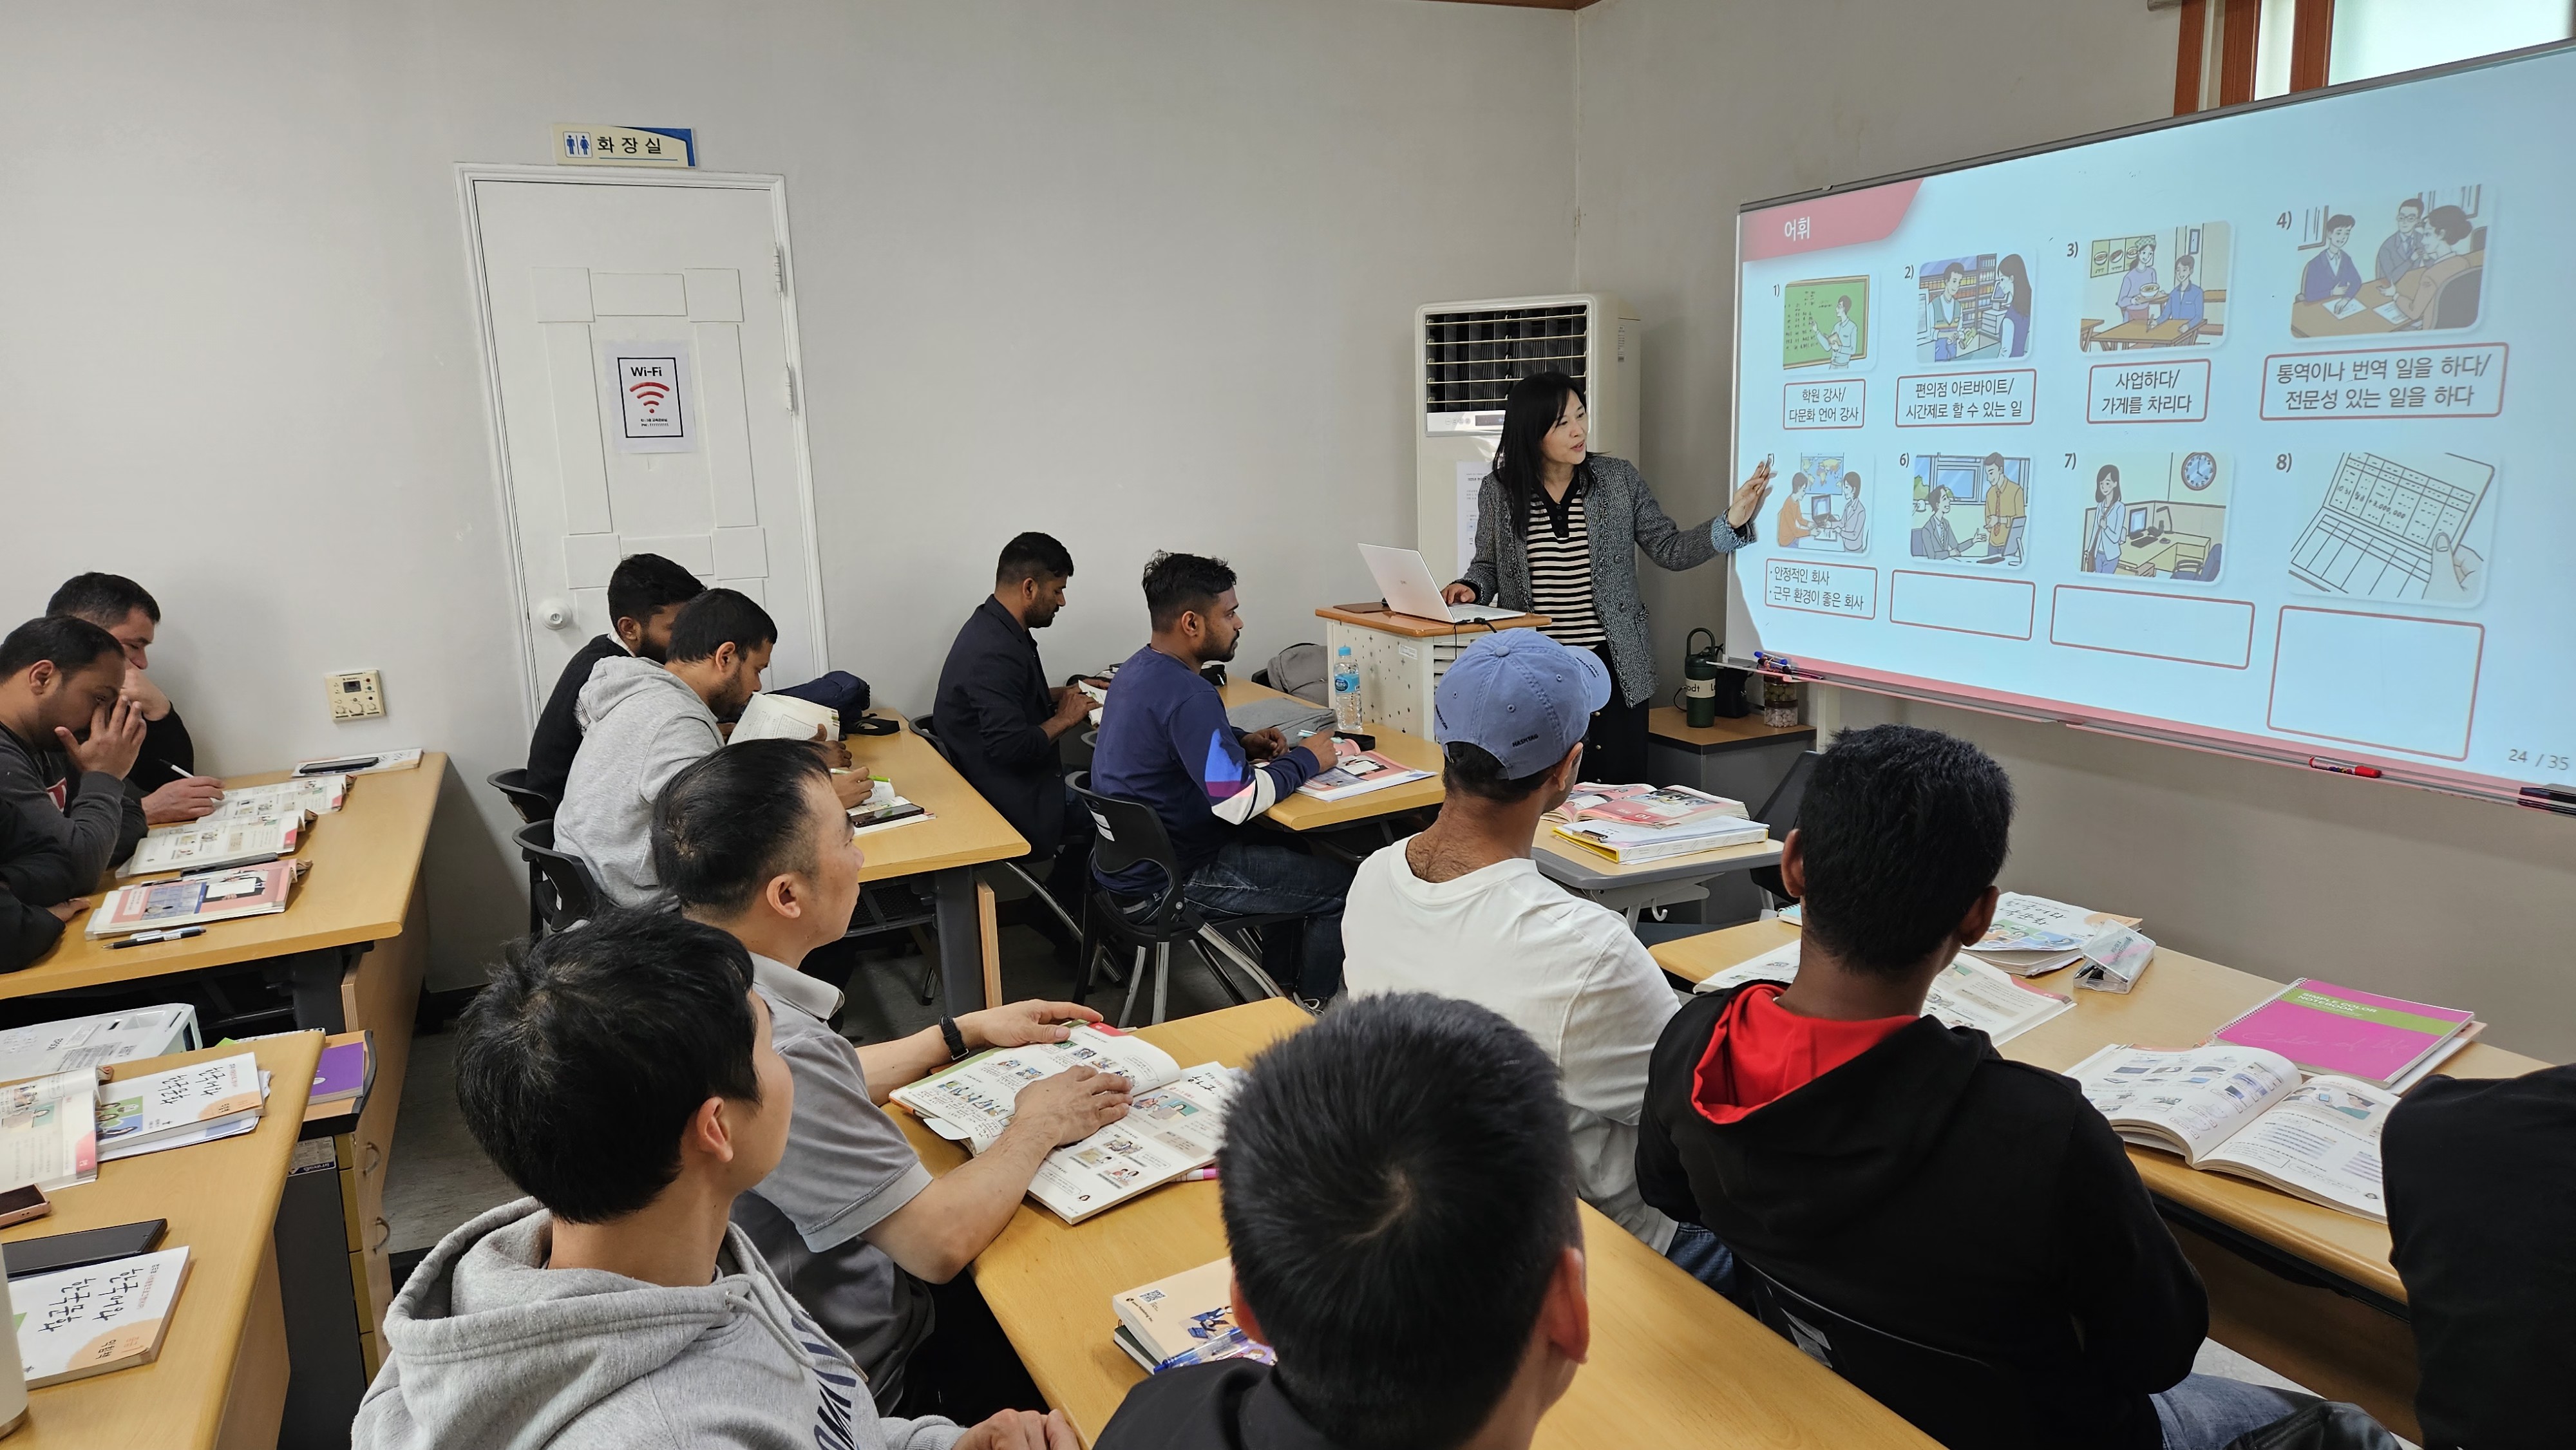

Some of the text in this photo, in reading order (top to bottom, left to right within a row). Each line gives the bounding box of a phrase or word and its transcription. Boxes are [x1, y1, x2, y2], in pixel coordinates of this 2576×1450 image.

[596, 135, 662, 155] 화장실
[1784, 216, 1811, 241] 어휘
[2277, 211, 2293, 231] 4)
[2067, 241, 2079, 258] 3)
[1904, 264, 1914, 280] 2)
[1774, 283, 1780, 298] 1)
[630, 366, 663, 377] Wi-Fi
[2116, 368, 2181, 390] 사업하다/
[2276, 353, 2493, 384] 통역이나 번역 일을 하다/
[1802, 386, 1846, 404] 학원 강사/
[1915, 377, 2015, 399] 편의점 아르바이트/
[2286, 385, 2474, 411] 전문성 있는 일을 하다
[1789, 406, 1859, 423] 다문화 언어 강사
[1906, 399, 2023, 420] 시간제로 할 수 있는 일
[2102, 394, 2192, 416] 가게를 차리다
[1899, 453, 1910, 468] 6)
[2065, 453, 2077, 470] 7)
[2276, 453, 2293, 473] 8)
[1774, 566, 1830, 587] 안정적인 회사
[1774, 586, 1864, 611] 근무 환경이 좋은 회사
[1512, 733, 1539, 748] HASHTAG
[2508, 748, 2570, 771] 24 / 35
[2297, 994, 2354, 1012] NOTEBOOK
[2302, 992, 2339, 1006] SIMPLE
[2340, 1002, 2378, 1013] COLOR
[158, 1074, 191, 1105] 한국문화
[37, 1277, 97, 1332] 한국문화
[92, 1268, 144, 1321] 한국어와
[95, 1339, 117, 1360] 익힘책
